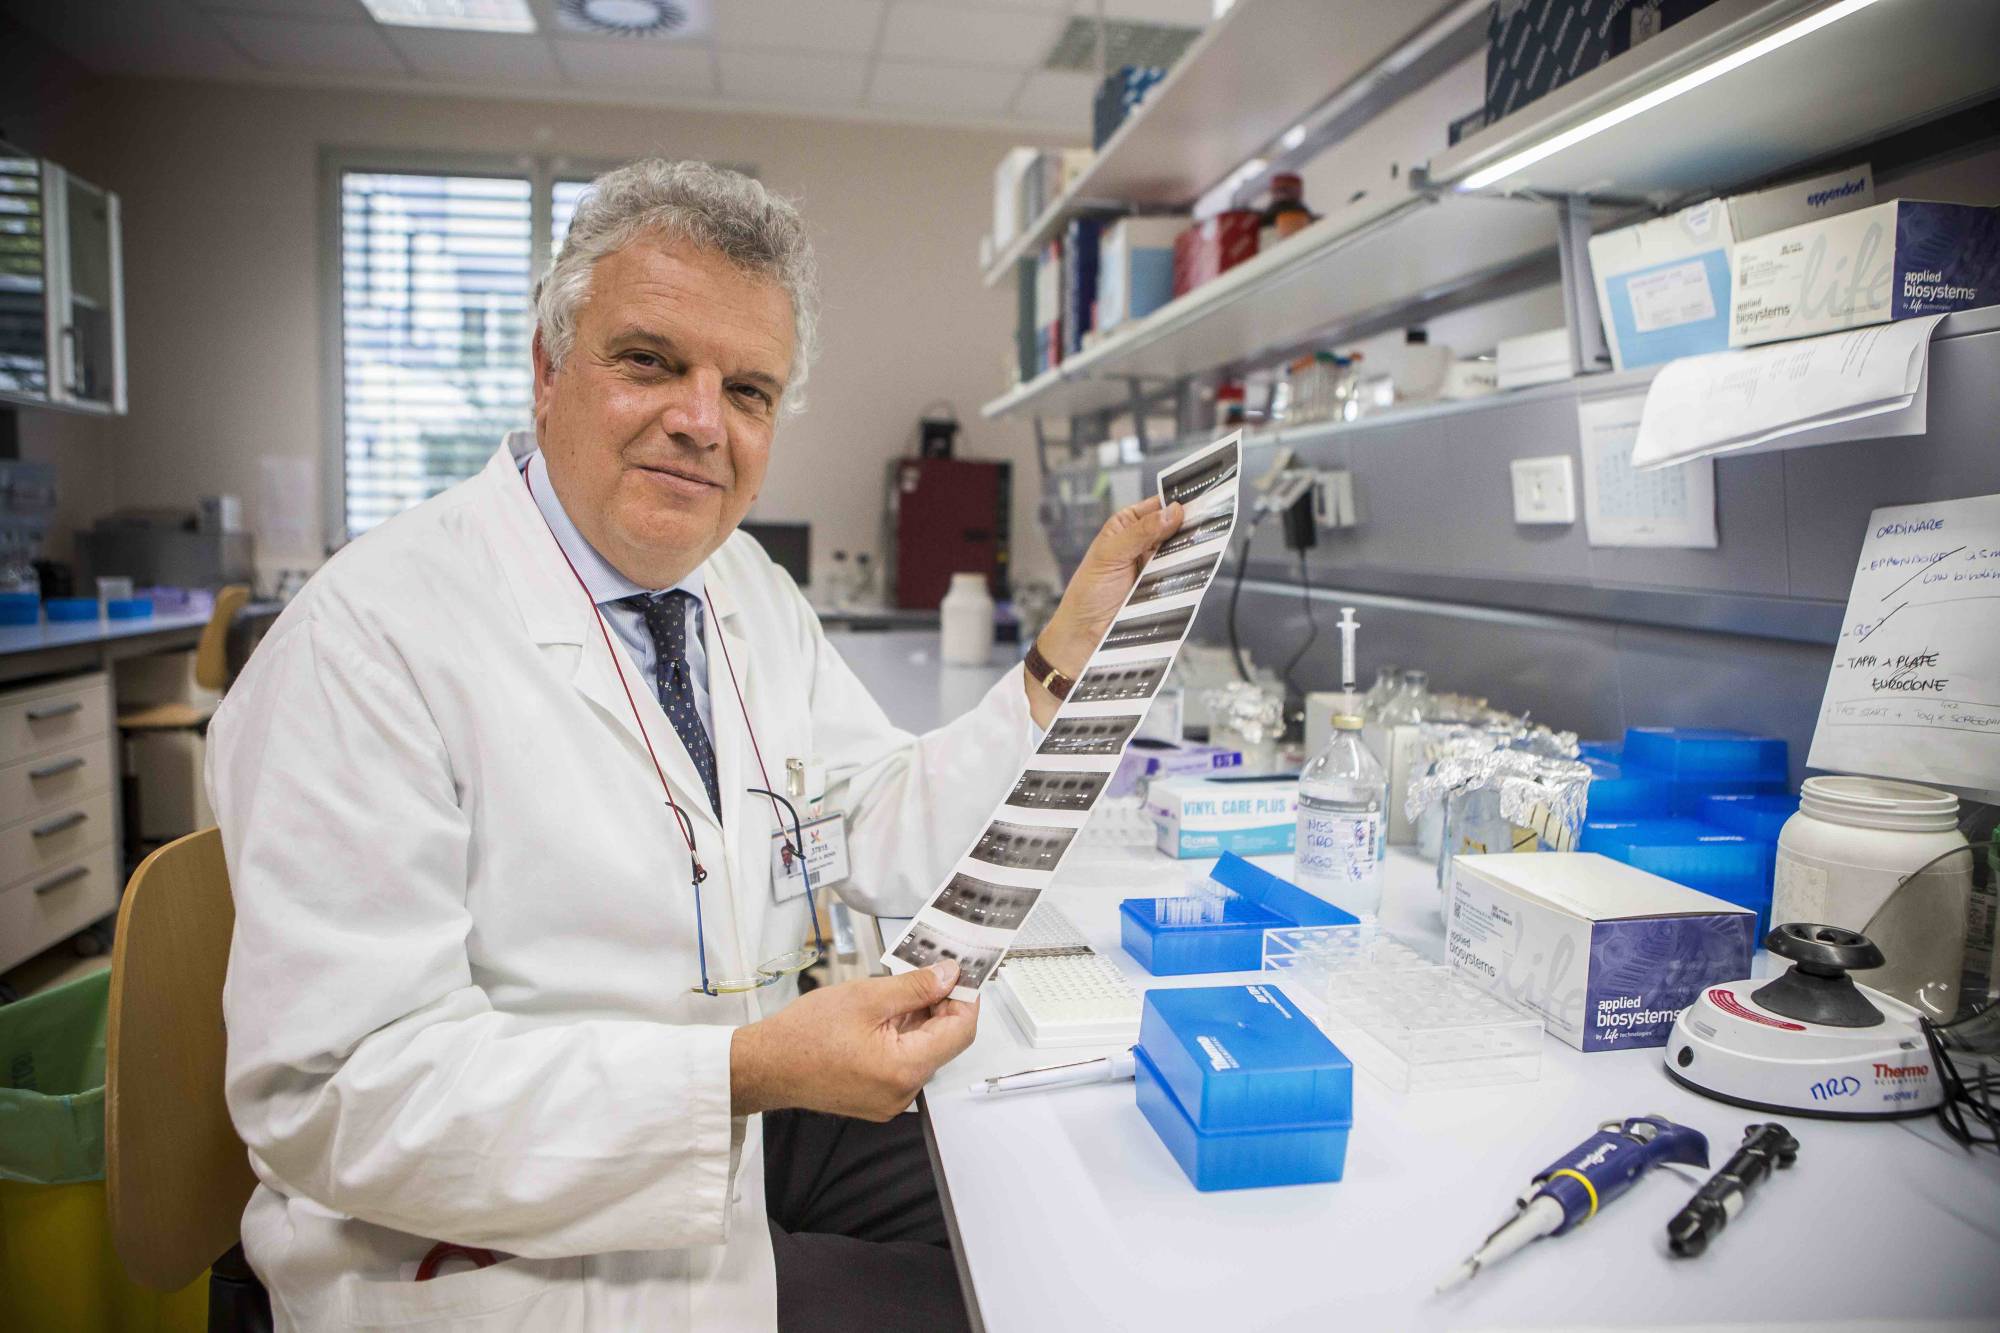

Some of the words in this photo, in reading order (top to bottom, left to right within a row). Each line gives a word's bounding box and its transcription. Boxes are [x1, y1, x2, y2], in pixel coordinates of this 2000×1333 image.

[1807, 177, 1865, 207] eppendorf
[1905, 270, 1942, 284] applied
[1904, 282, 1976, 302] biosystems
[1876, 519, 1944, 539] ORDINARE
[1896, 652, 1940, 668] PLATE
[1222, 799, 1252, 815] CARE
[1256, 798, 1286, 814] PLUS
[1449, 942, 1496, 978] biosystems
[1598, 994, 1642, 1013] applied
[1596, 1008, 1681, 1030] biosystems
[1602, 1028, 1619, 1044] life
[1872, 1063, 1930, 1079] Thermo
